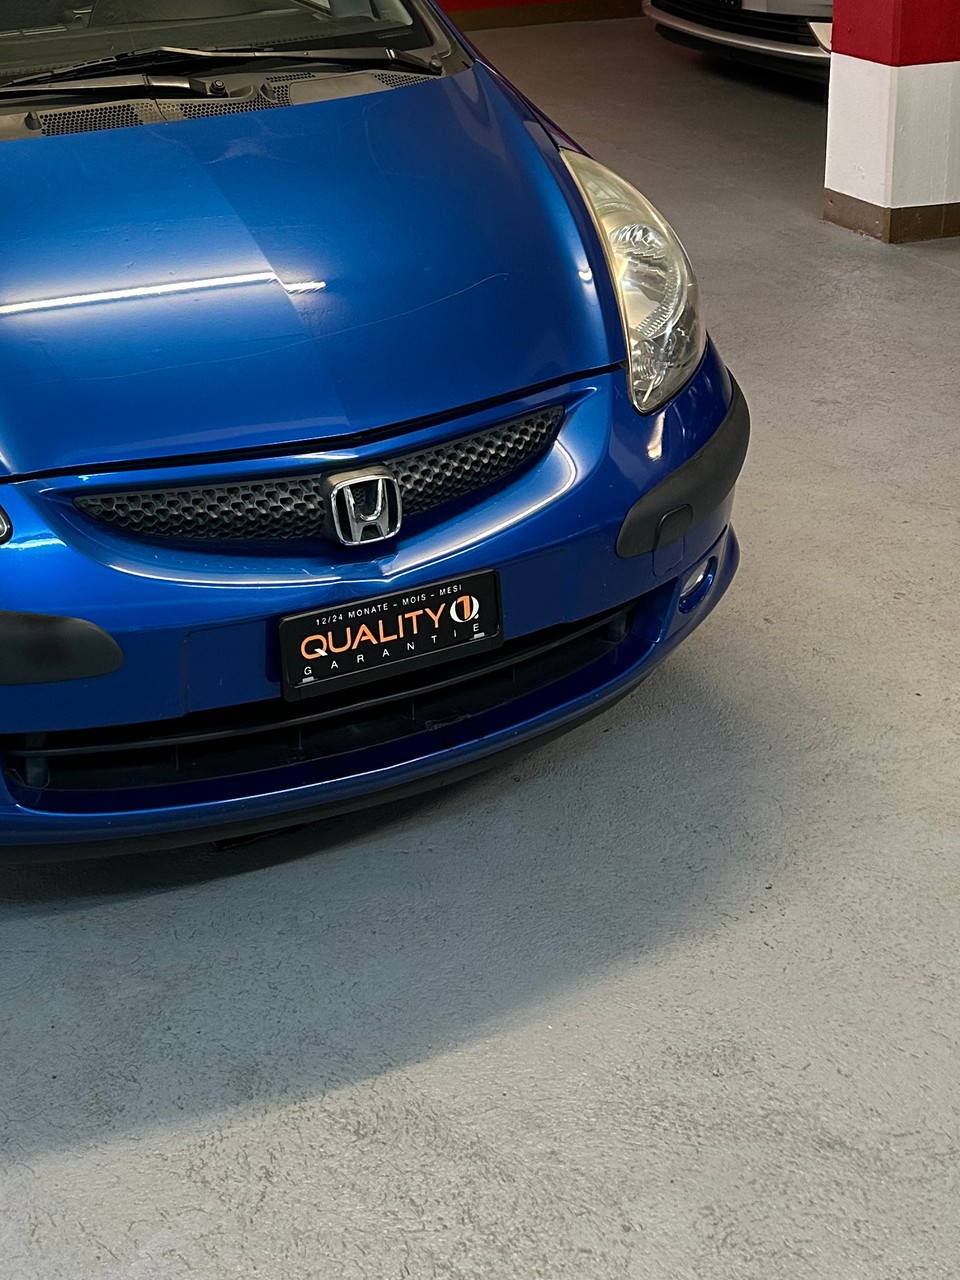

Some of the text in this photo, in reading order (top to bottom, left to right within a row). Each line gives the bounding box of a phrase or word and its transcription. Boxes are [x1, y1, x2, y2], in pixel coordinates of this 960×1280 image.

[300, 602, 447, 660] QUALITY
[315, 613, 344, 626] 12/24
[348, 602, 389, 619] MONATE
[402, 593, 427, 606] MOIS
[439, 584, 463, 596] MESI
[303, 622, 481, 676] GARANTIE
